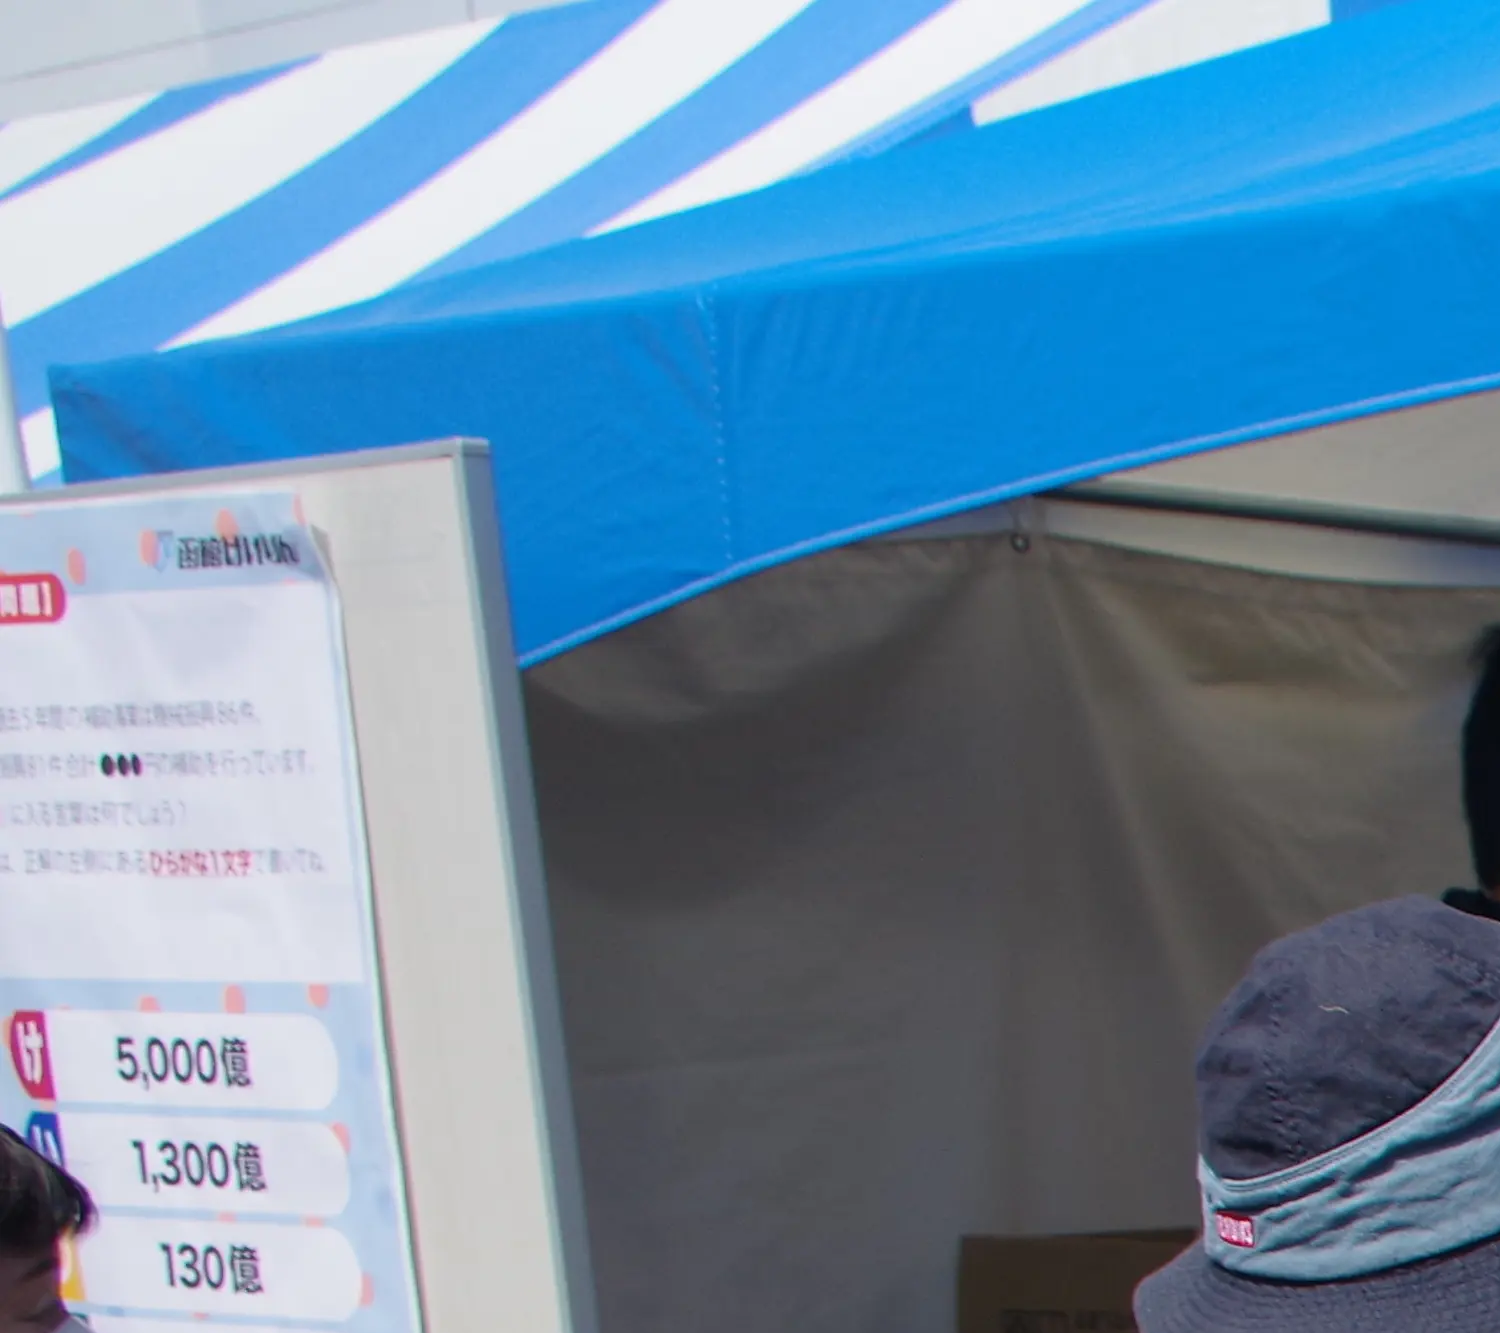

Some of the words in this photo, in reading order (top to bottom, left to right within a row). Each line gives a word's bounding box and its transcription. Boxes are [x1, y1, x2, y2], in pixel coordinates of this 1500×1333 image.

[115, 1036, 254, 1090] 5,000億
[131, 1139, 268, 1193] 1,300億
[158, 1243, 264, 1295] 130億
